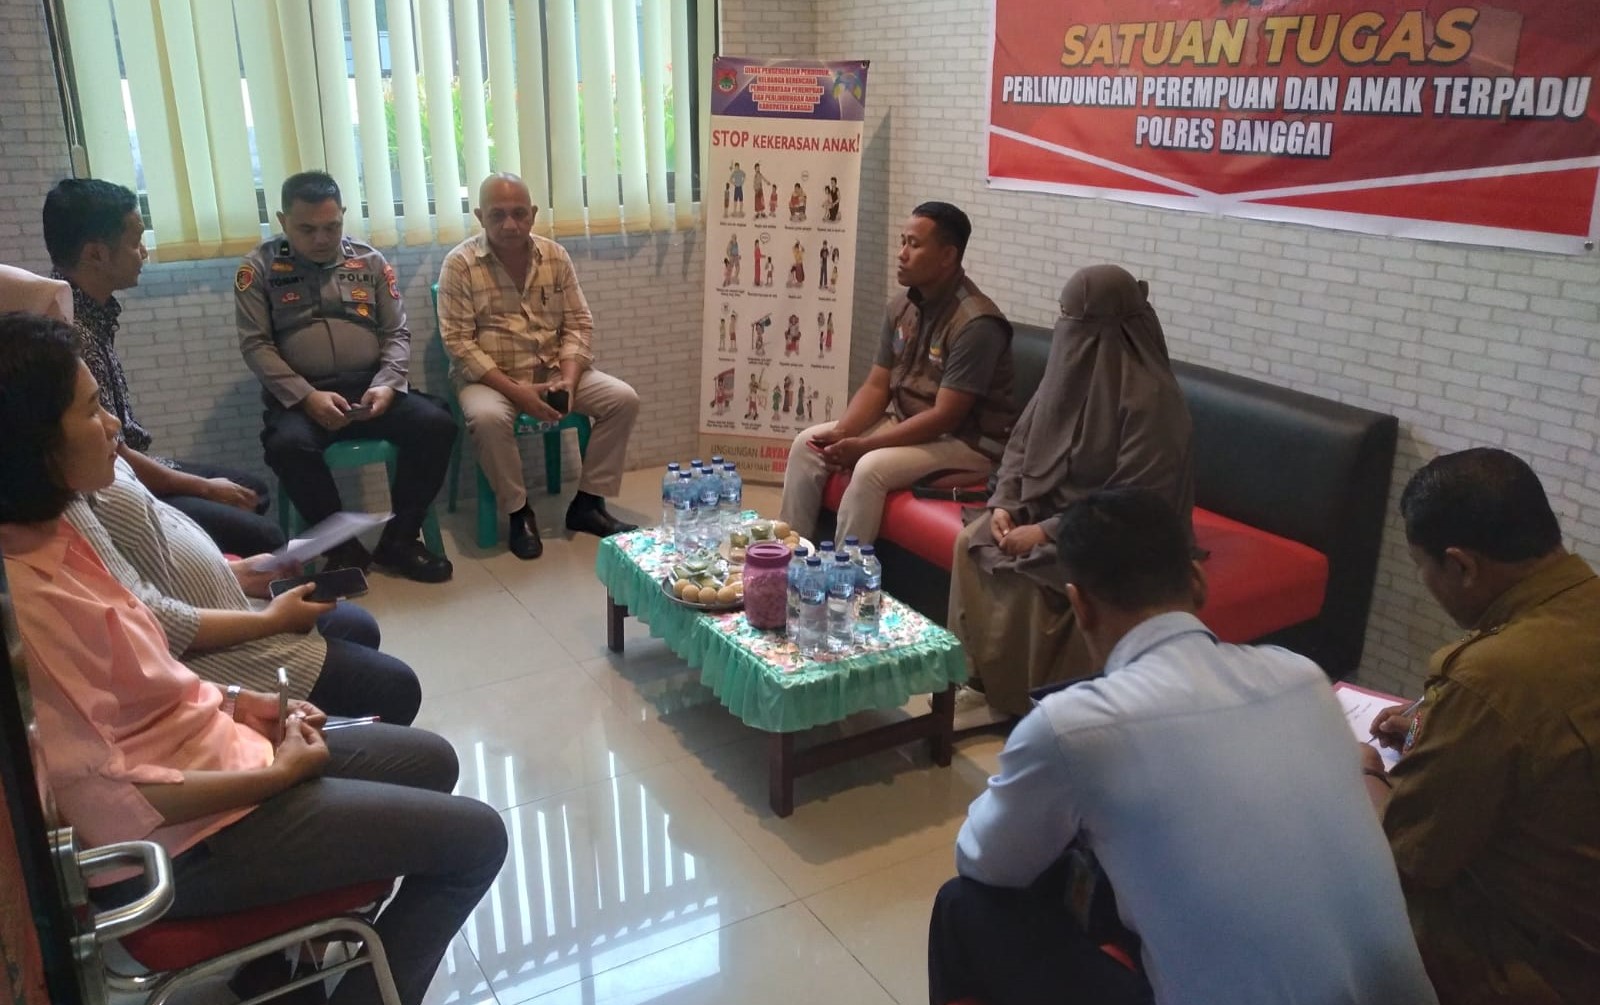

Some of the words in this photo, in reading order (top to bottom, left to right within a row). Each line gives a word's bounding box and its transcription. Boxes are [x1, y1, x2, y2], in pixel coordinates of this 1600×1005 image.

[1060, 18, 1249, 66] SATUAN
[1265, 8, 1480, 65] TUGAS
[1002, 76, 1138, 106] PERLINDUNGAN
[1142, 76, 1278, 109] PEREMPUAN
[1283, 76, 1339, 112] DAN
[1342, 76, 1426, 114] ANAK
[1433, 76, 1592, 119] TERPADU
[712, 129, 749, 147] STOP
[752, 135, 819, 151] KEKERASAN
[822, 133, 861, 153] ANAK!
[1135, 116, 1215, 149] POLRES
[1220, 118, 1333, 157] BANGGAI
[339, 273, 375, 284] POLRI
